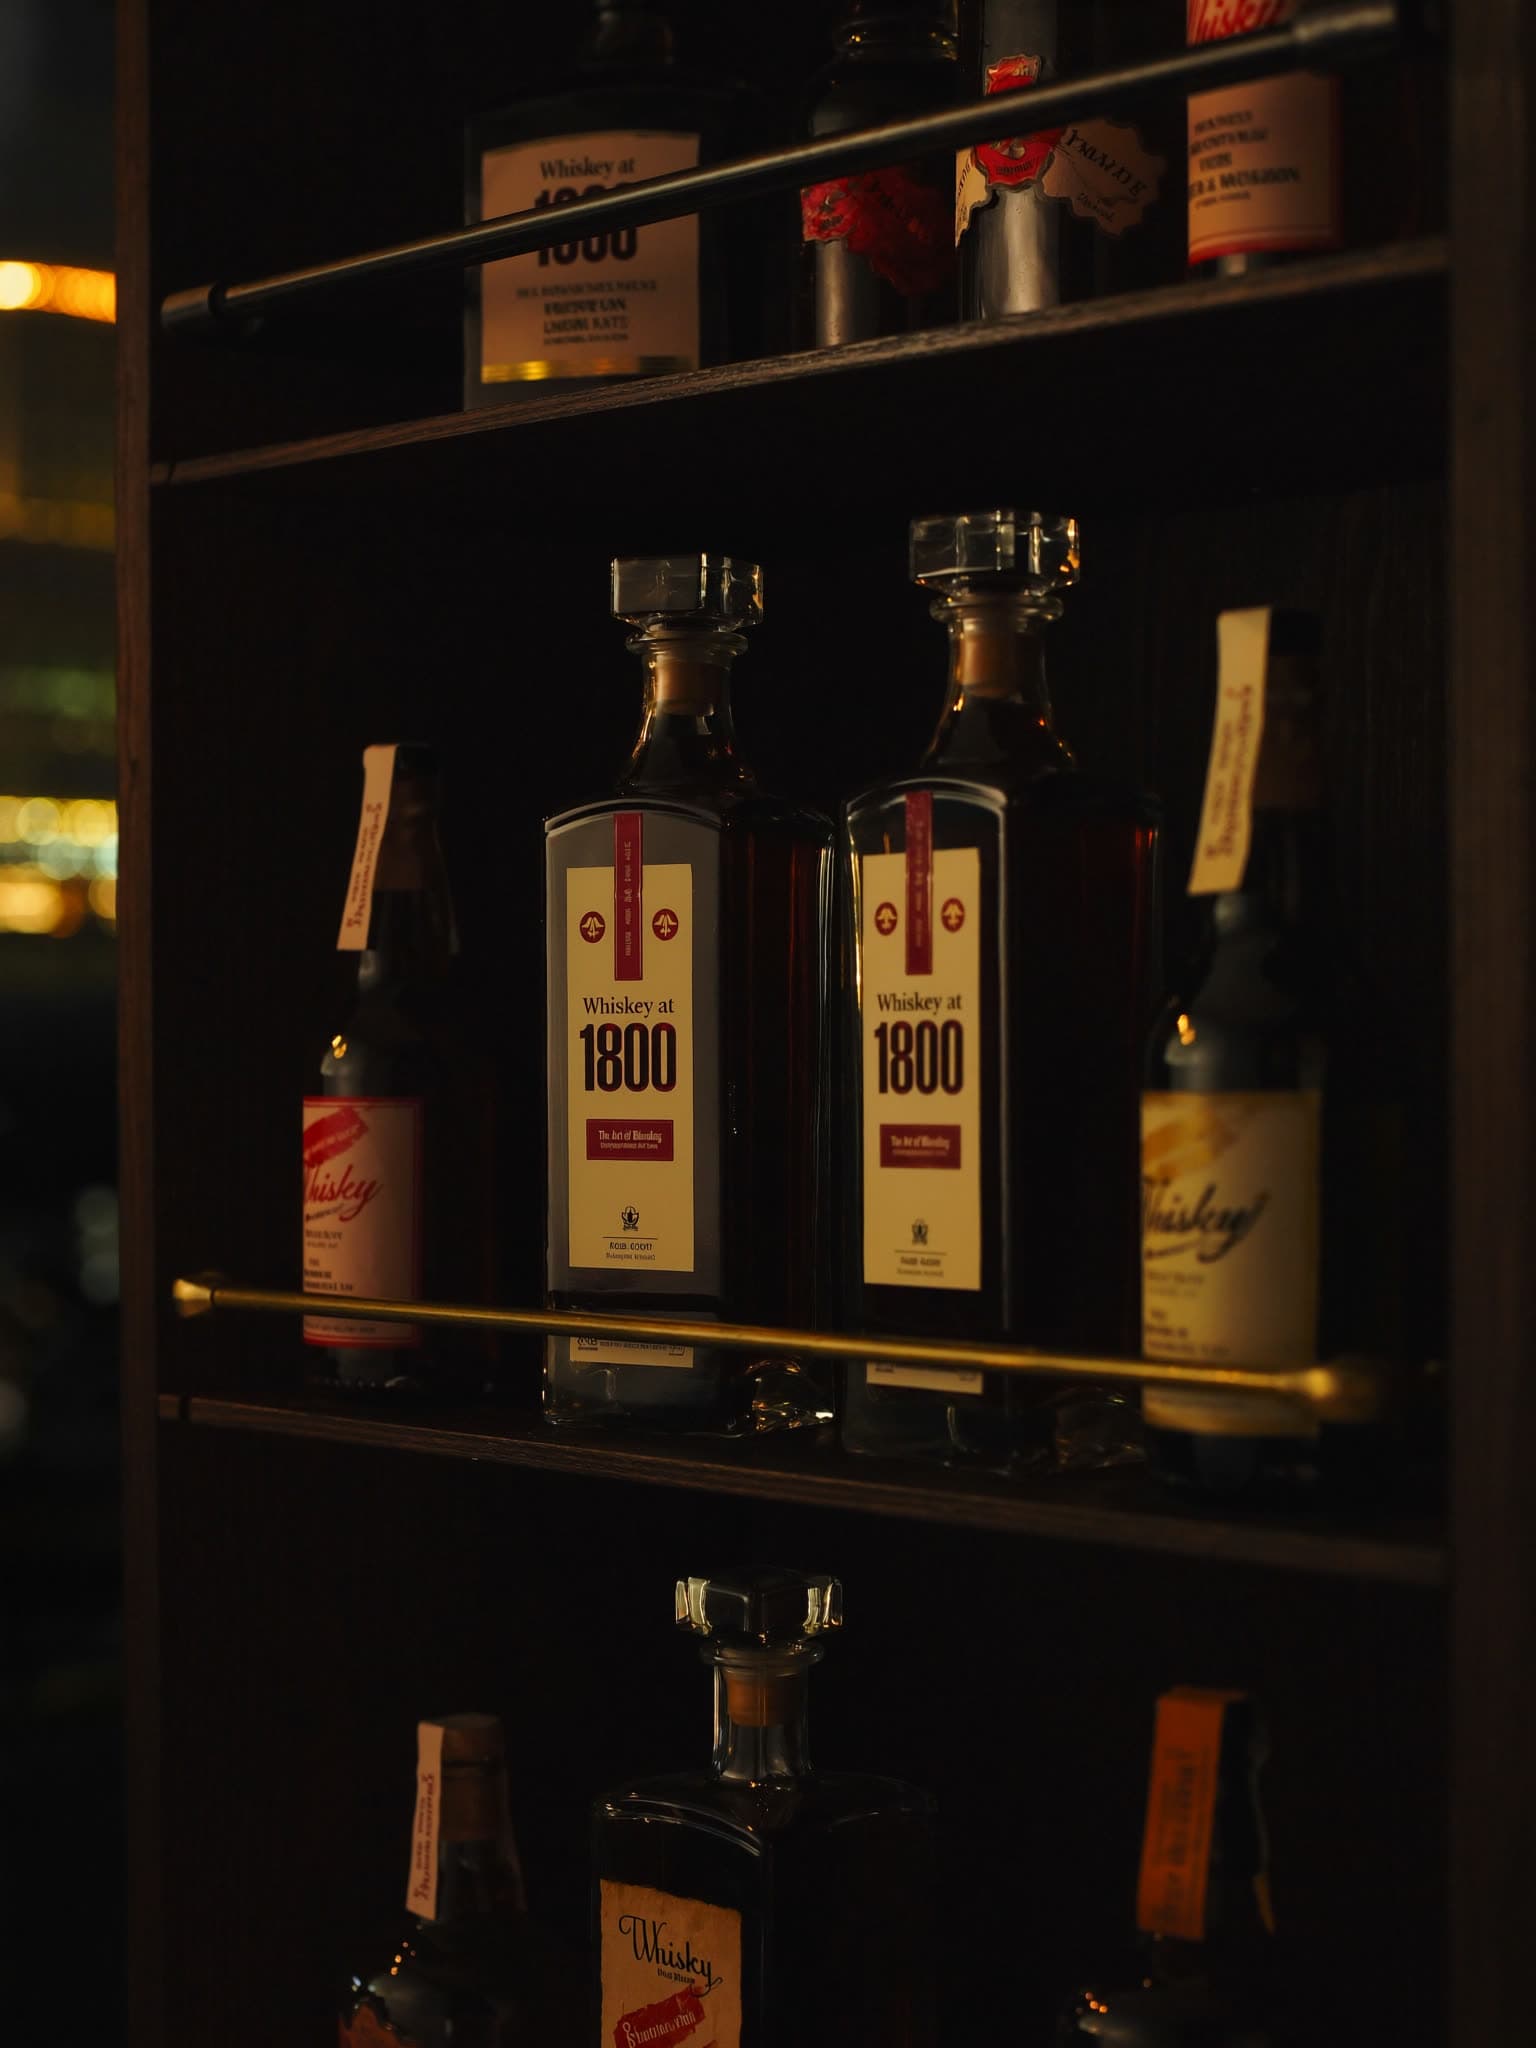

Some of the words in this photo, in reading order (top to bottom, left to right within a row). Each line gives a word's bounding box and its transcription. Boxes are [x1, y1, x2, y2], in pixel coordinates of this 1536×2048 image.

[541, 157, 615, 180] Whiskey
[618, 157, 635, 174] at
[583, 996, 654, 1018] Whiskey
[658, 998, 675, 1014] at
[877, 992, 943, 1012] Whiskey
[947, 993, 962, 1011] at
[580, 1022, 677, 1092] 1800
[875, 1020, 964, 1095] 1800
[618, 1914, 723, 1998] Whisky
